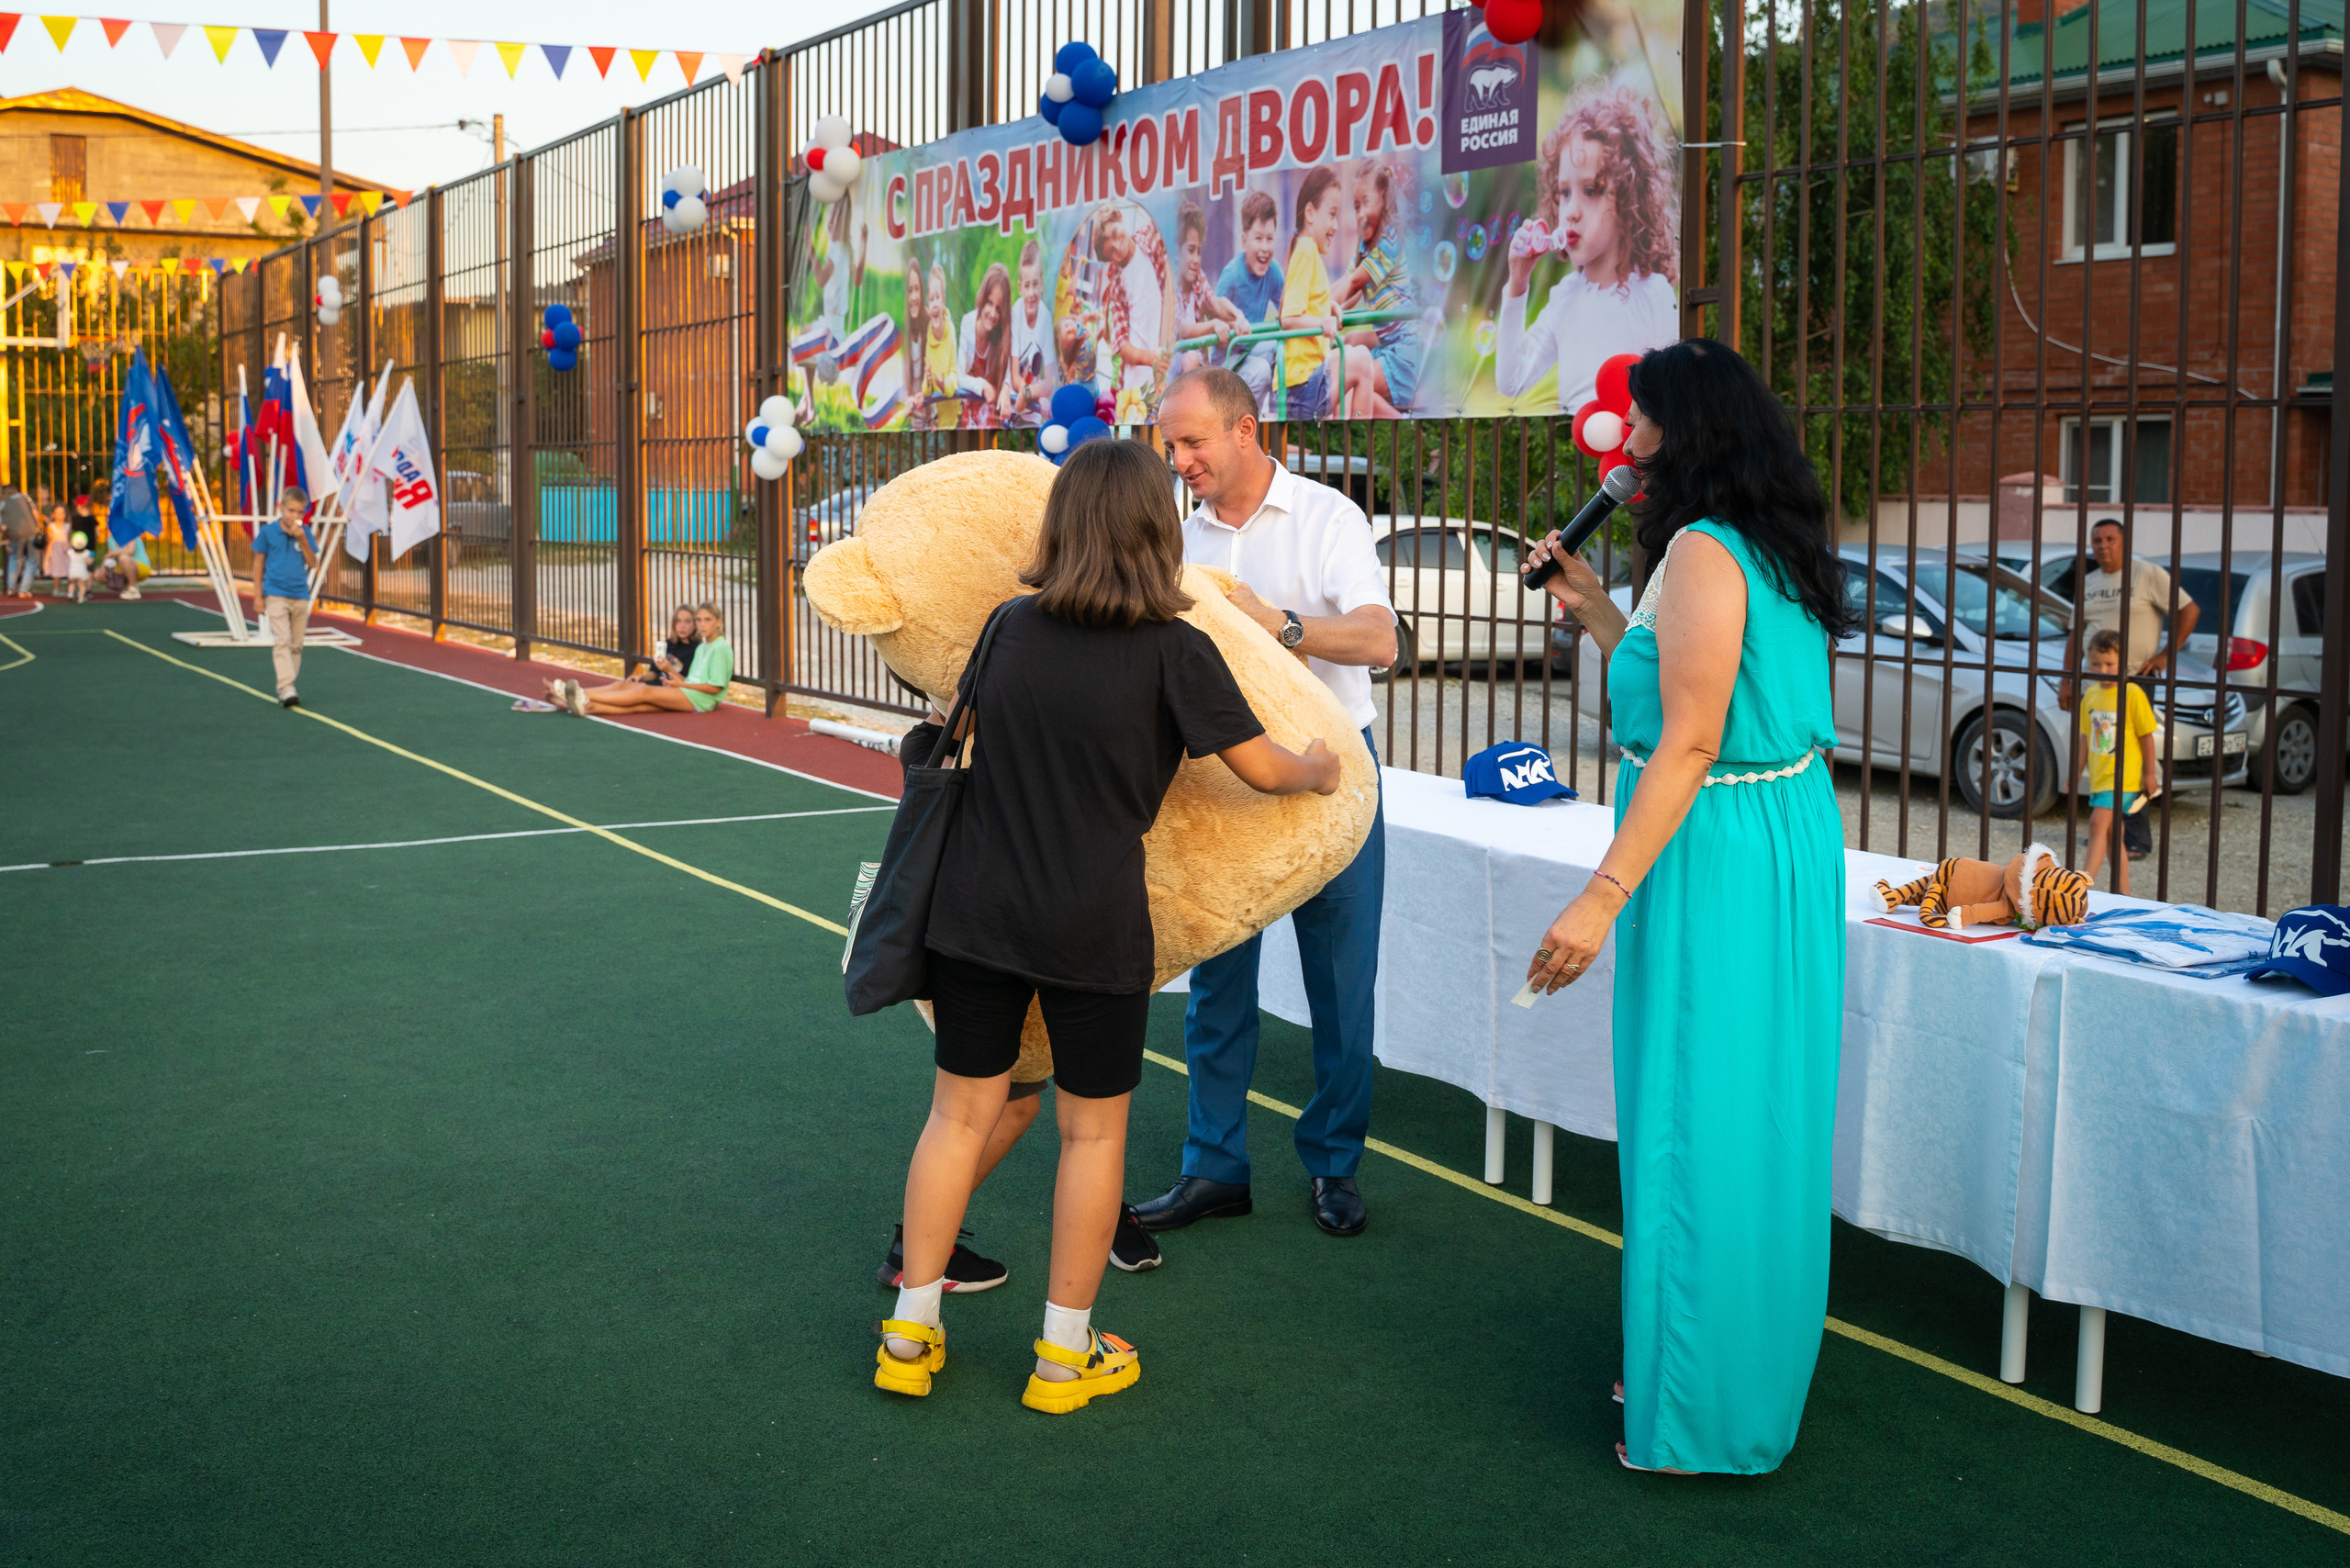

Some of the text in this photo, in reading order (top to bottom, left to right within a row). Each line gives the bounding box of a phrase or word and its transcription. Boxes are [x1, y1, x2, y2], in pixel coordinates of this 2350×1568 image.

[1460, 108, 1519, 135] ЕДИНАЯ
[884, 51, 1436, 241] С ПРАЗДНИКОМ ДВОРА!
[1460, 128, 1518, 153] РОССИЯ
